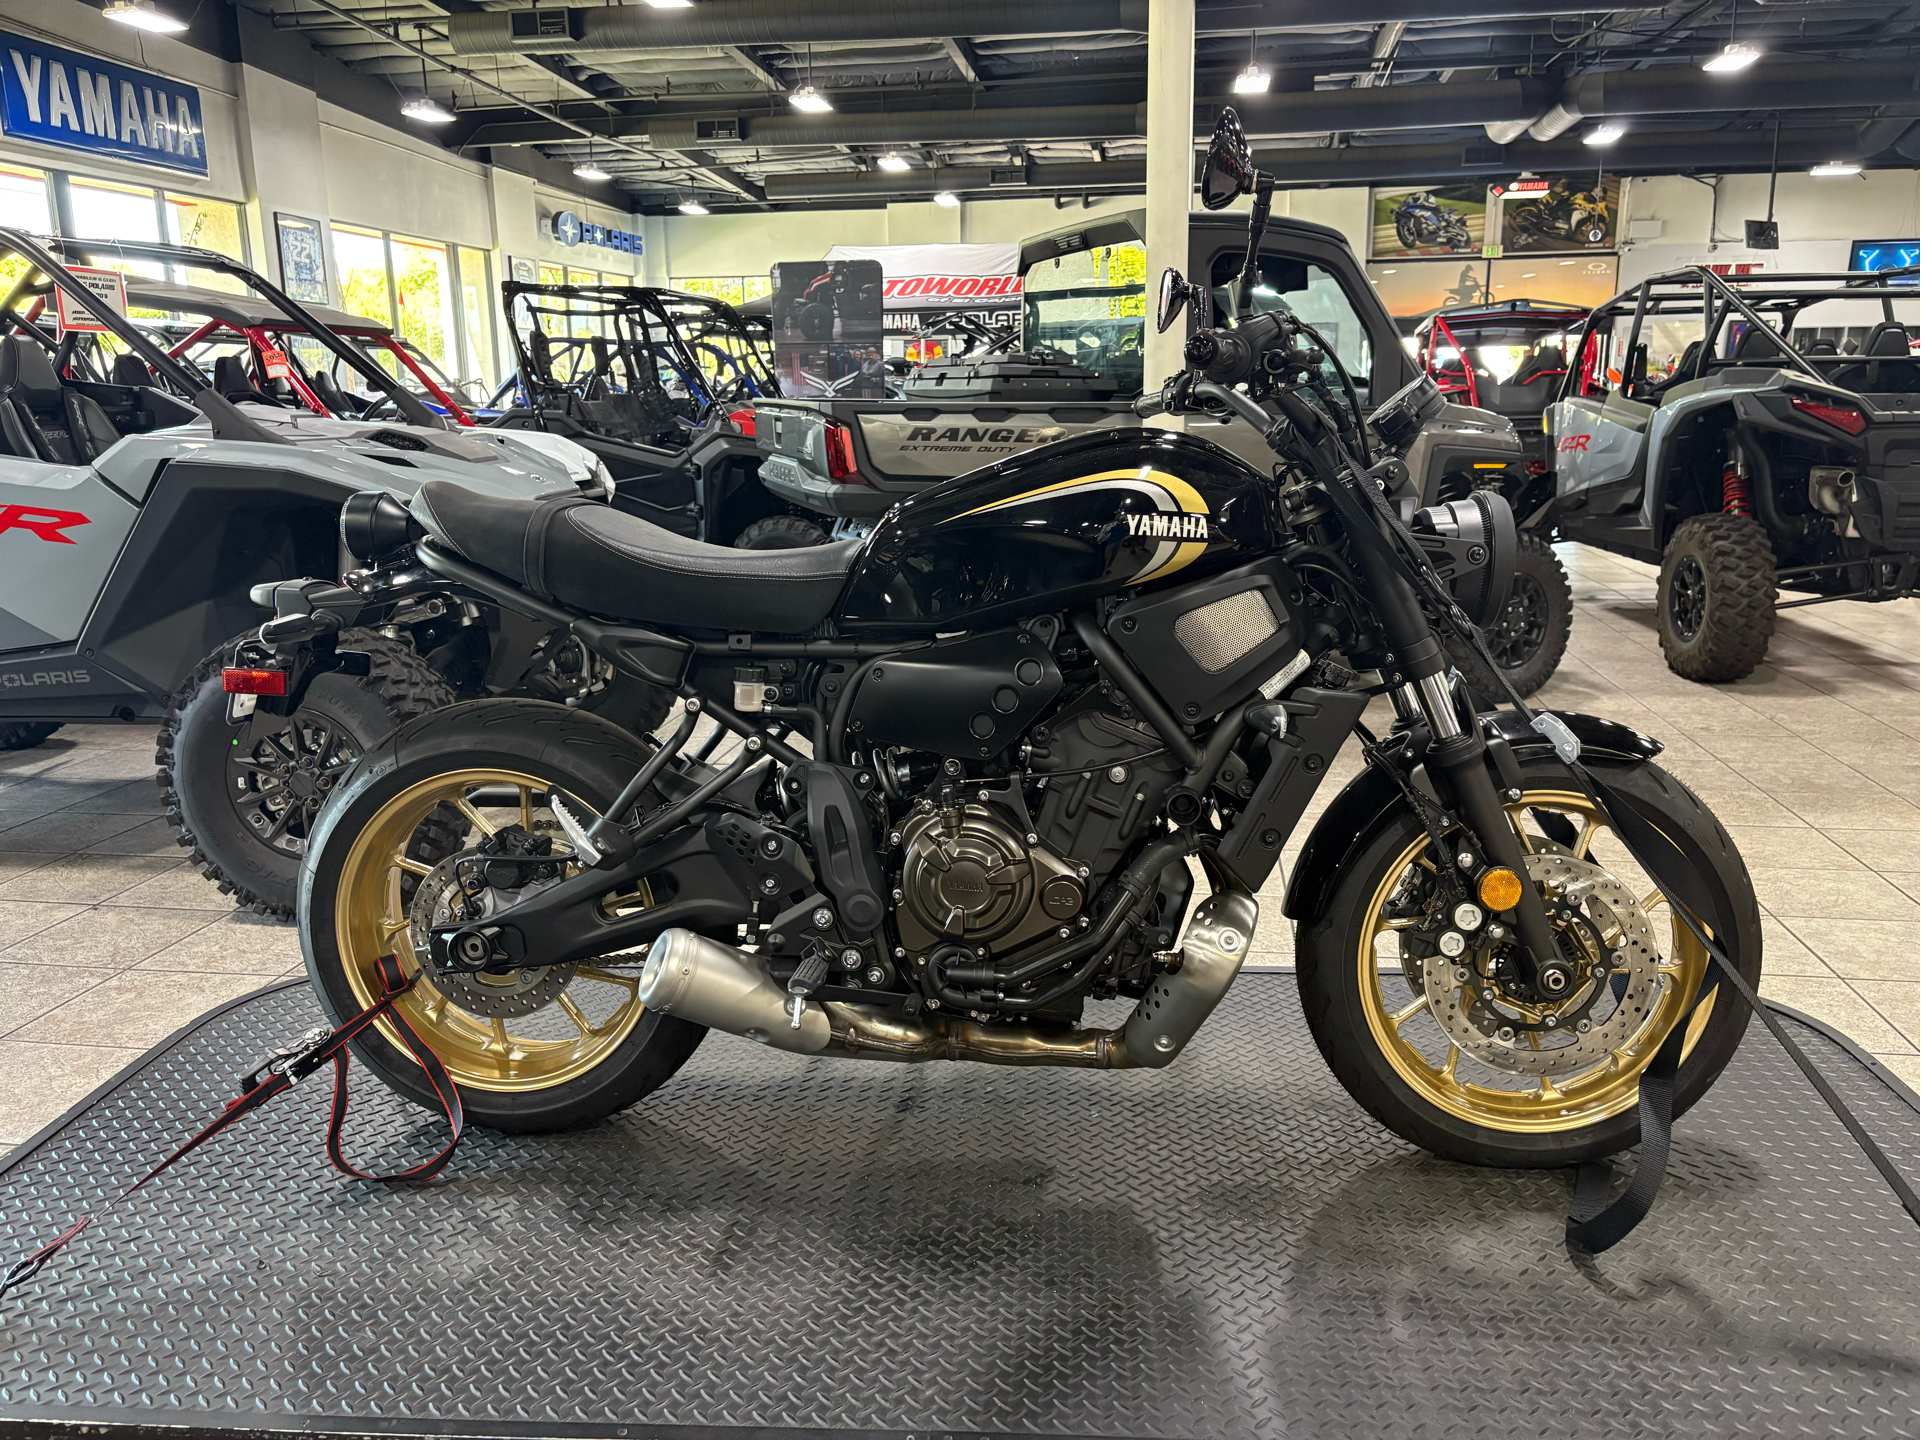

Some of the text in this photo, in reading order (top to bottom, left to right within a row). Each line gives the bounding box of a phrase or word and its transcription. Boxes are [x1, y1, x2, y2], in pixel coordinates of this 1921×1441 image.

[9, 49, 200, 159] YAMAHA
[1518, 181, 1549, 191] YAMAHA
[582, 221, 643, 256] POLARIS
[89, 282, 116, 291] POLARIS
[883, 313, 921, 330] MAHA
[265, 352, 283, 363] SOLD
[906, 426, 1068, 444] RANGER
[899, 445, 971, 453] EXTREME
[1126, 514, 1209, 539] YAMAHA
[0, 669, 91, 687] OLARIS
